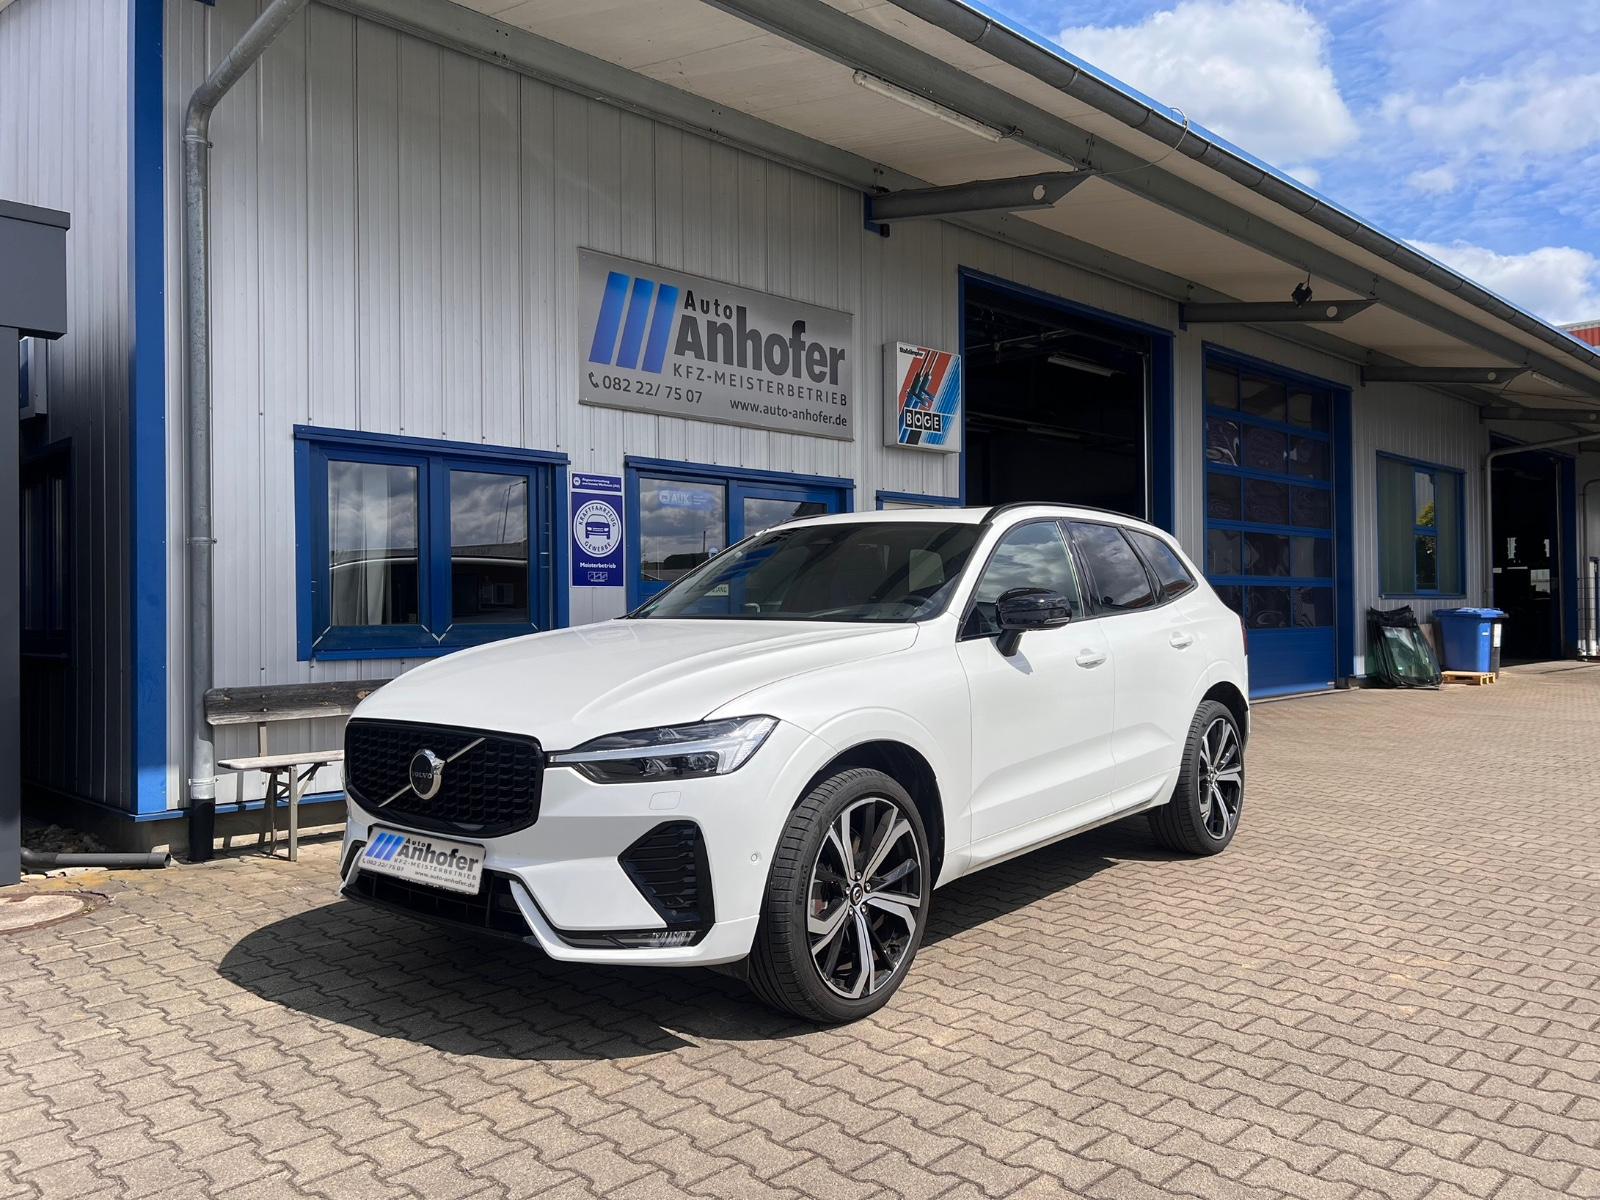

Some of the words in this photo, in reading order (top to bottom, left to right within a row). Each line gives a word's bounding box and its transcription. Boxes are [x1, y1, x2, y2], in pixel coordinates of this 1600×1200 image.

[684, 290, 732, 319] Auto
[674, 305, 845, 386] Anhofer
[602, 375, 631, 393] 082
[665, 385, 682, 401] 75
[686, 389, 703, 404] 07
[673, 363, 847, 406] KFZ-MEISTERBETRIEB
[730, 399, 847, 427] www.auto-anhofer.de
[906, 412, 940, 430] BOGE
[578, 505, 617, 527] KRAFTFAHRZEUG
[405, 837, 426, 848] Auto
[394, 858, 477, 881] KFZ-MEISTERBETRIEB
[397, 843, 479, 873] Anhofer
